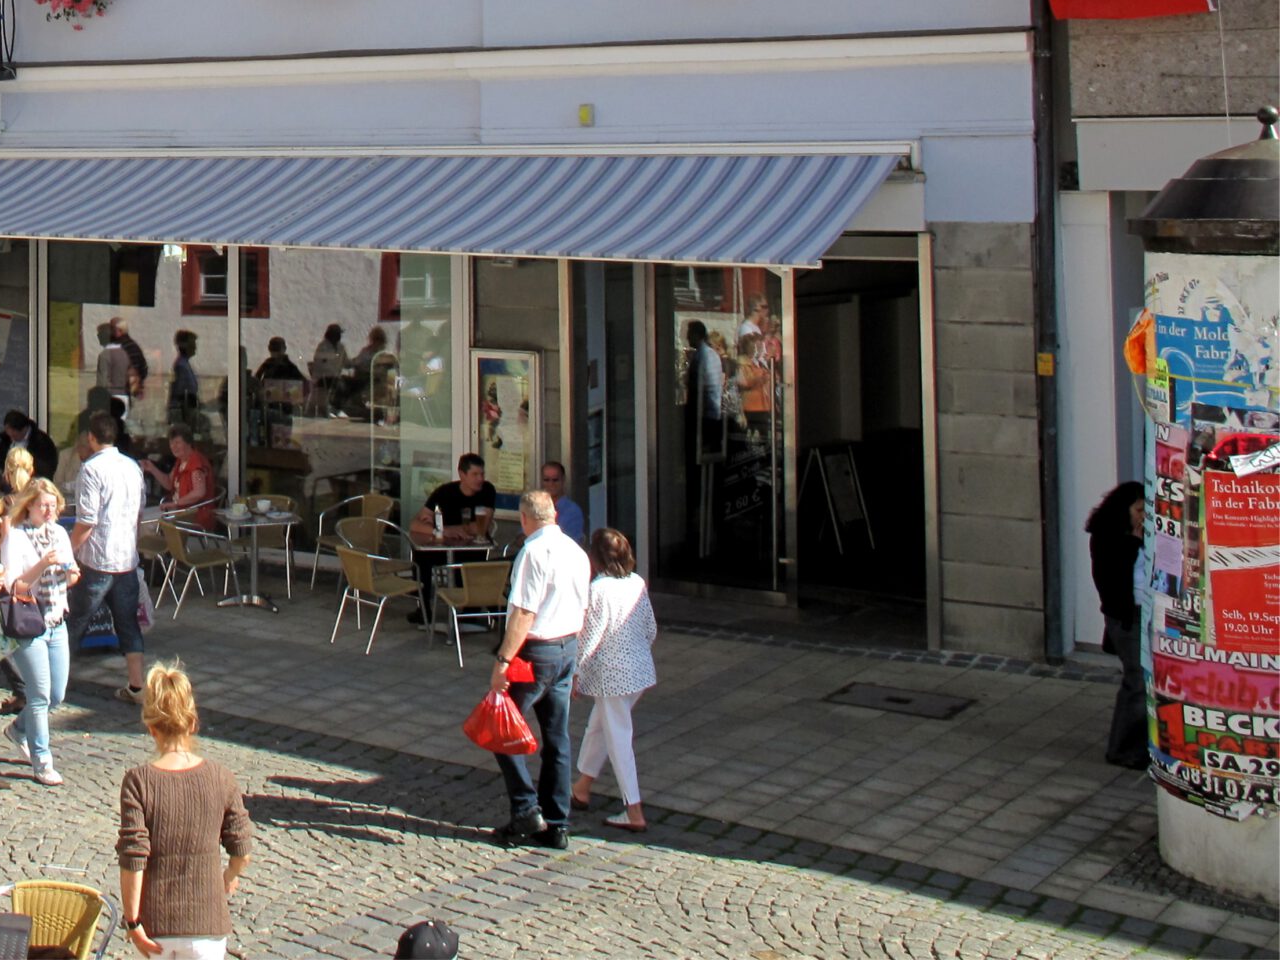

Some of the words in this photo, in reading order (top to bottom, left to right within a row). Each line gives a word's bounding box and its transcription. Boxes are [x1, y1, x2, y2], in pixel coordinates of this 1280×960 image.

[1169, 322, 1187, 337] der
[1212, 496, 1222, 508] in
[1225, 497, 1245, 510] der
[1222, 609, 1246, 622] Selb,
[1251, 624, 1274, 635] Uhr
[1160, 637, 1279, 670] KULMAIN
[1183, 704, 1279, 739] BECK
